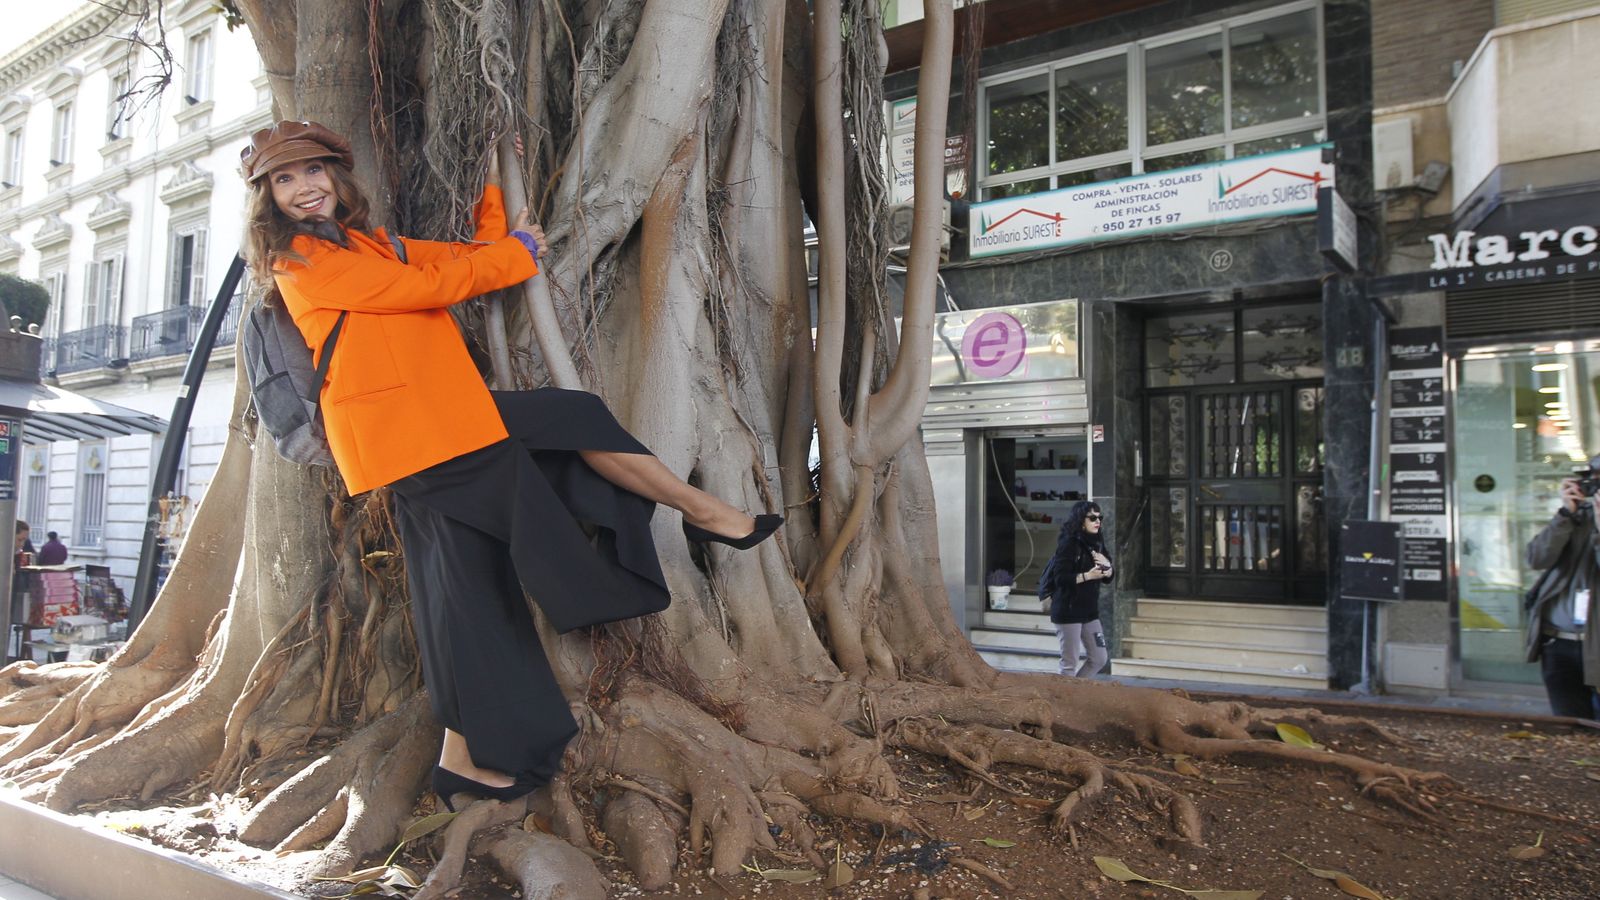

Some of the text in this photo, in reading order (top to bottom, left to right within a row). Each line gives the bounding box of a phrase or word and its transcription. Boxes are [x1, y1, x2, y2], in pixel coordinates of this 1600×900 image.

[1072, 189, 1111, 202] COMPRA
[1120, 182, 1151, 194] VENTA
[1159, 173, 1203, 188] SOLARES
[1094, 189, 1179, 209] ADMINISTRACION
[1208, 191, 1270, 213] Inmobiliaria
[1111, 203, 1161, 218] DE FINCAS
[1102, 212, 1182, 232] 950 27 15 97
[973, 230, 1021, 248] Inmobiliaria
[1214, 254, 1229, 268] 92
[1429, 276, 1448, 288] LA
[1485, 266, 1547, 282] CADENA
[1556, 262, 1577, 275] DE
